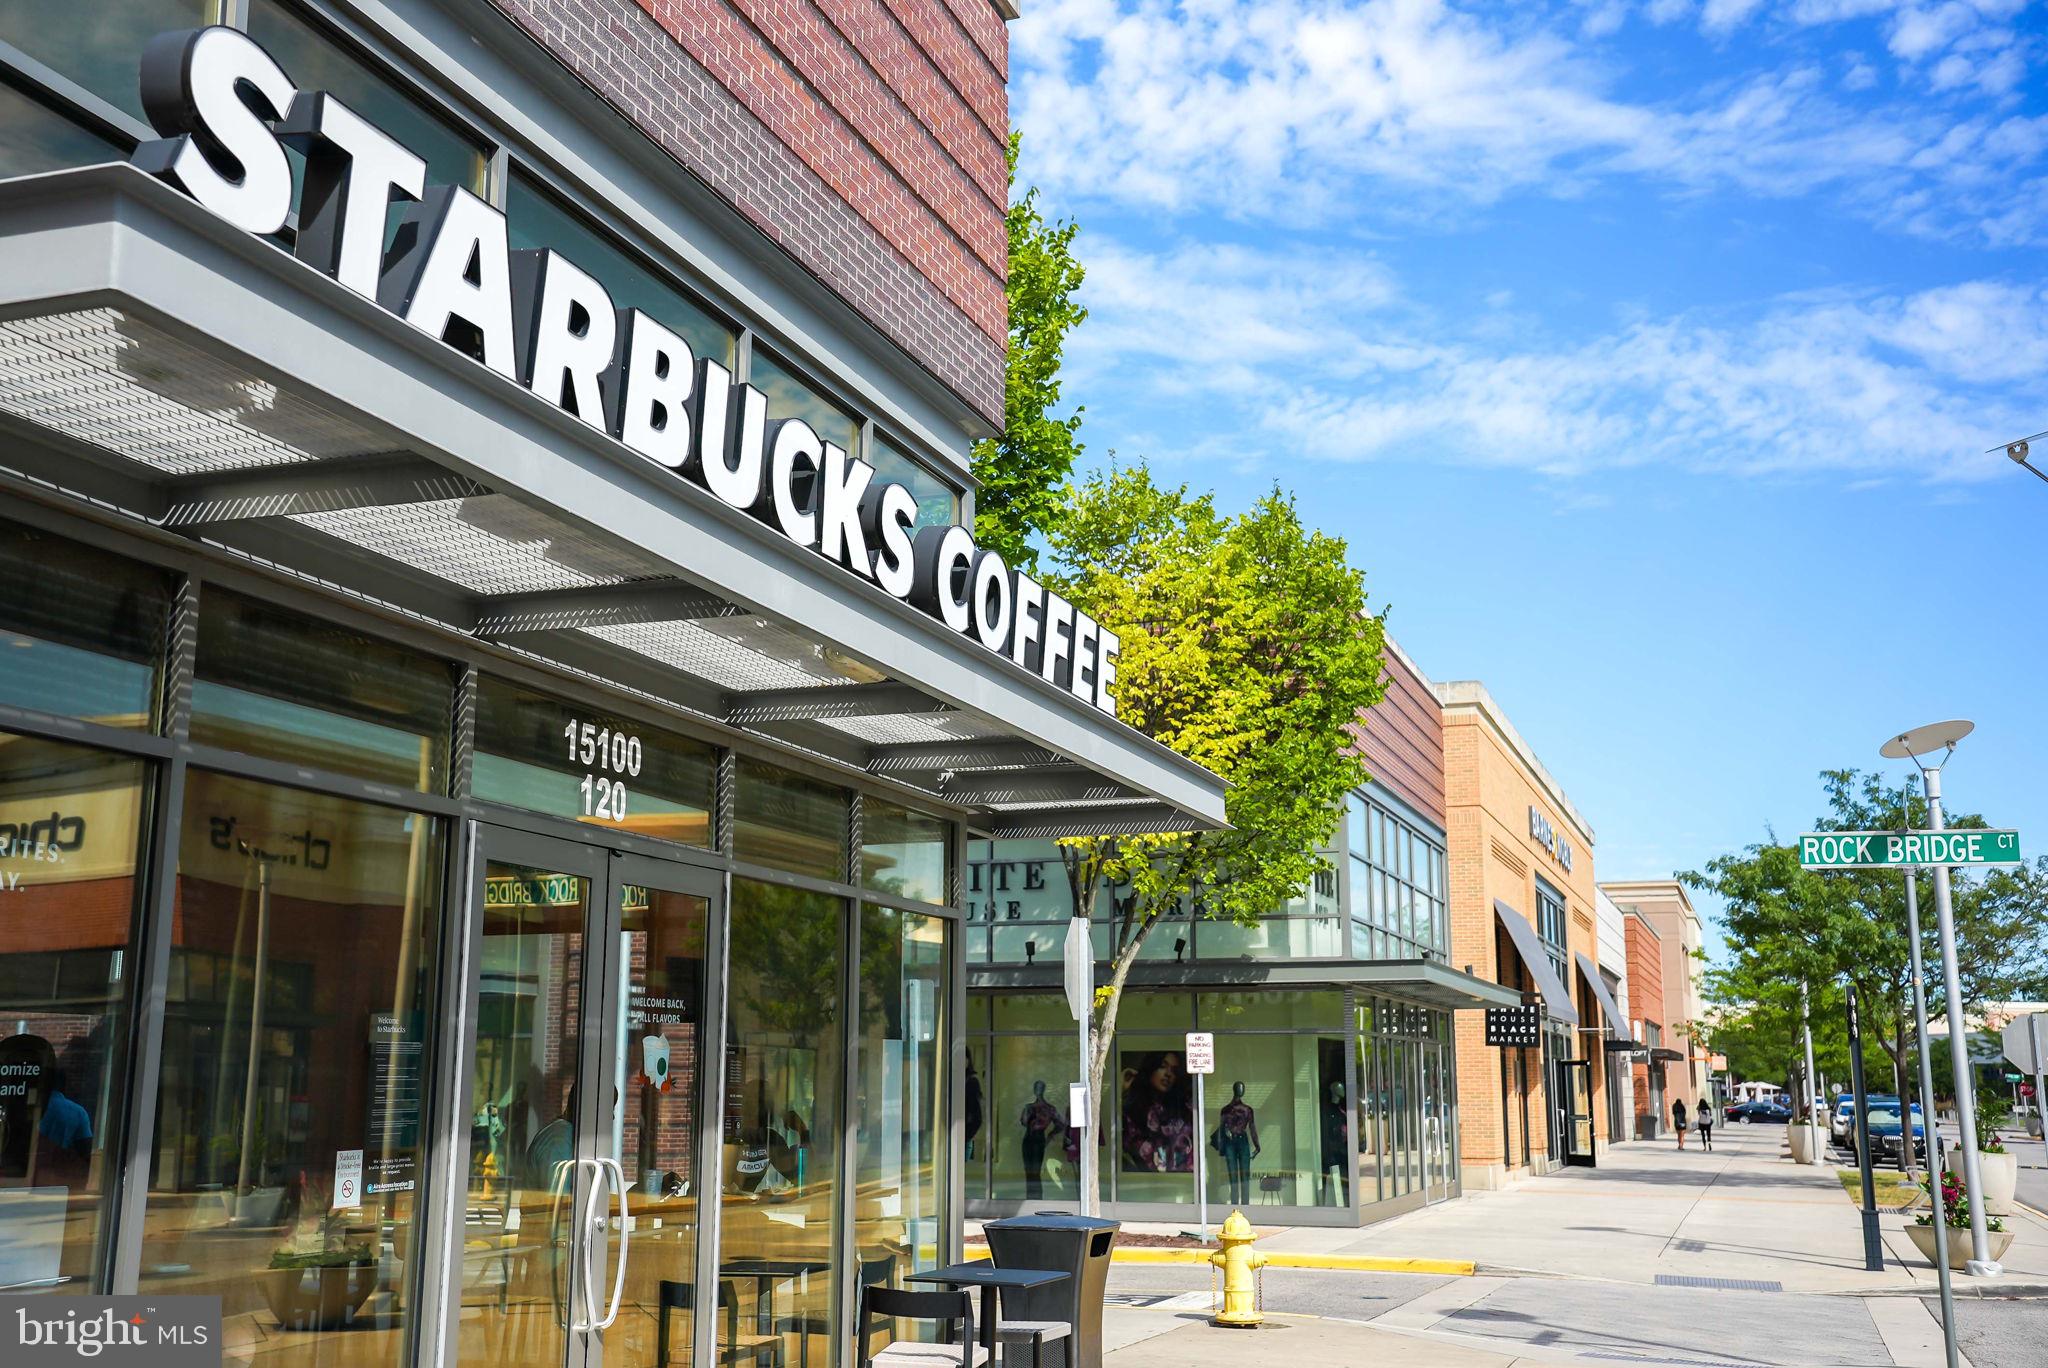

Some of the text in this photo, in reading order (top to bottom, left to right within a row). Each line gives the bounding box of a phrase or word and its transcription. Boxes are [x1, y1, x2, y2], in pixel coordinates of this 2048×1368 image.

[168, 24, 1121, 717] STARBUCKS COFFEE
[564, 718, 642, 777] 15100
[581, 773, 627, 822] 120
[1803, 834, 2015, 864] ROCK BRIDGE CT
[632, 997, 686, 1011] WELCOME BACK,
[652, 1013, 681, 1024] FLAVORS
[1490, 1015, 1535, 1023] HOUSE
[1490, 1025, 1536, 1034] BLACK
[1489, 1035, 1536, 1044] MARKET
[0, 1081, 26, 1096] and
